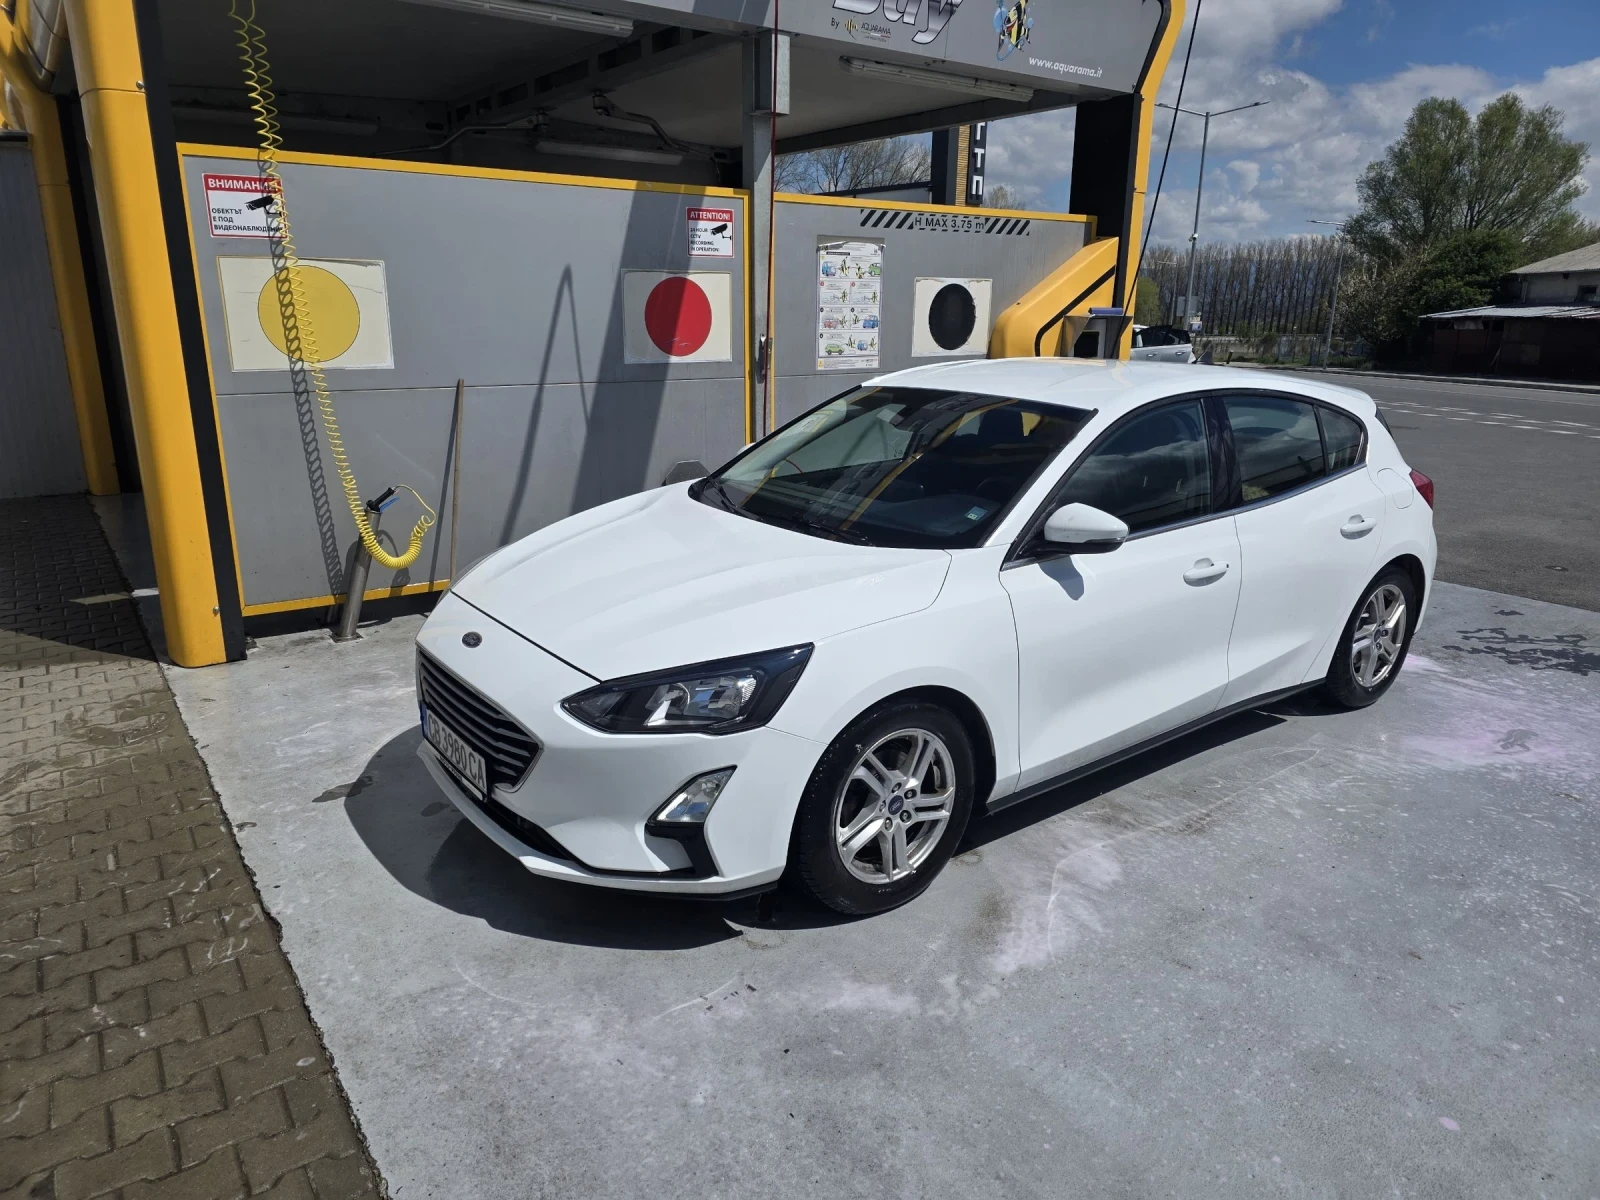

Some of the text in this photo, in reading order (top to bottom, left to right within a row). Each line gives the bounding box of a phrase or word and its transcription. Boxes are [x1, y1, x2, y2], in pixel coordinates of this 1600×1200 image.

[831, 17, 892, 35] By AQUARAMA
[1029, 57, 1103, 78] www.aquarama.it
[211, 207, 242, 215] ОБЕКТЪТ
[690, 211, 731, 220] ATTENTION!
[914, 217, 985, 230] H MAX 3.75 m
[427, 713, 441, 746] CB
[441, 726, 468, 771] 3980
[468, 751, 486, 790] CA
